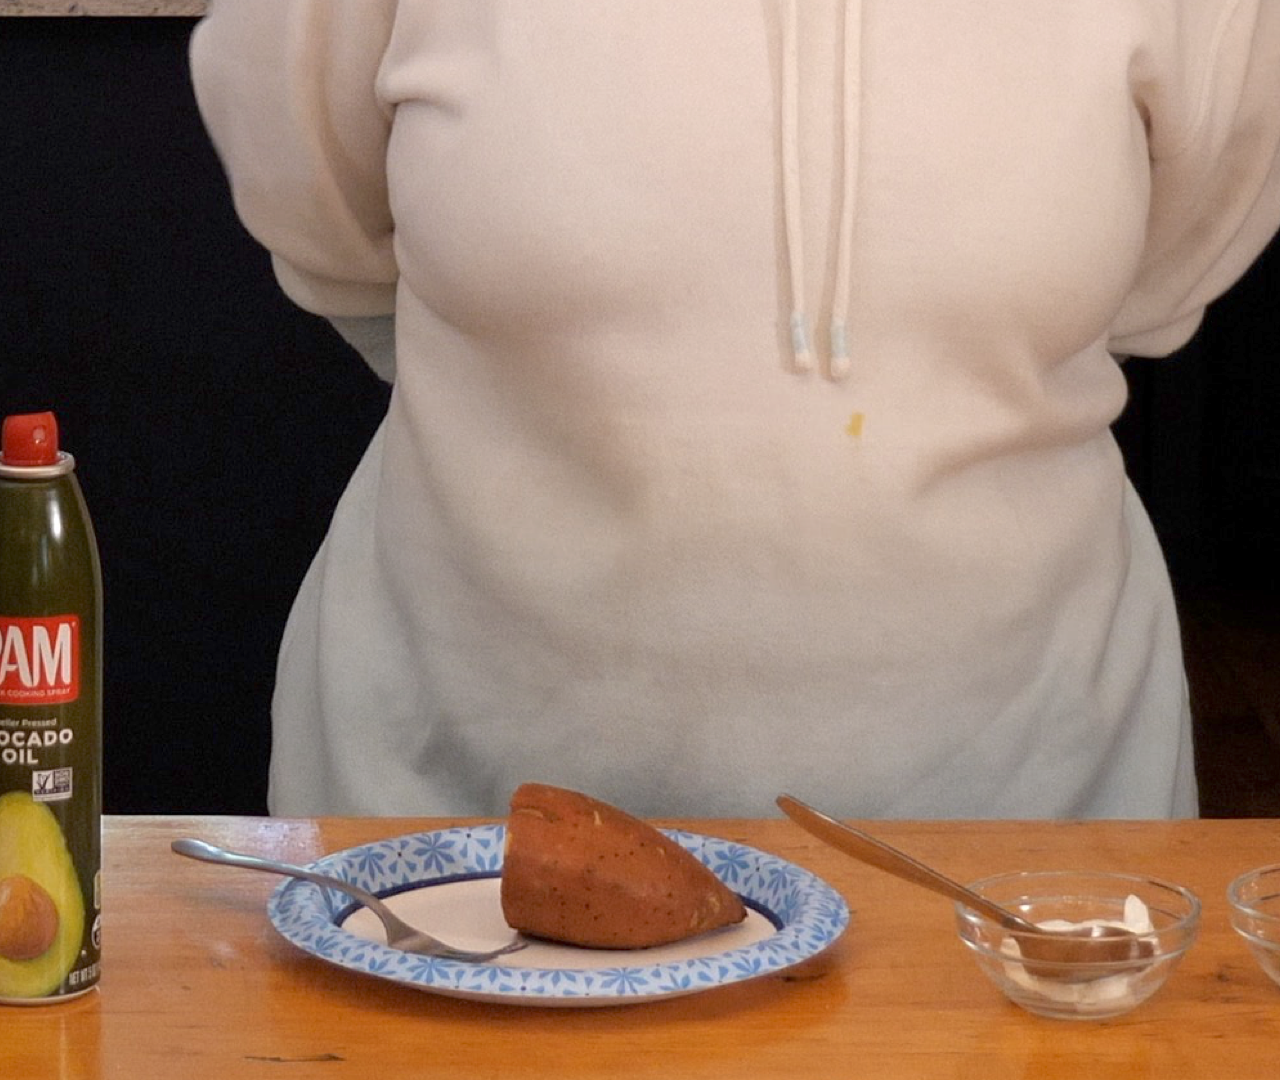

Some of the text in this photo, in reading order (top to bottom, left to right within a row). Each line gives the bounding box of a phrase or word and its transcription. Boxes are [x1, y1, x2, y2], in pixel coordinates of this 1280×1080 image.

[6, 688, 45, 698] COOKING
[46, 686, 71, 696] SPRAY
[21, 717, 58, 727] Pressed
[1, 748, 40, 765] OIL
[68, 970, 80, 986] NET
